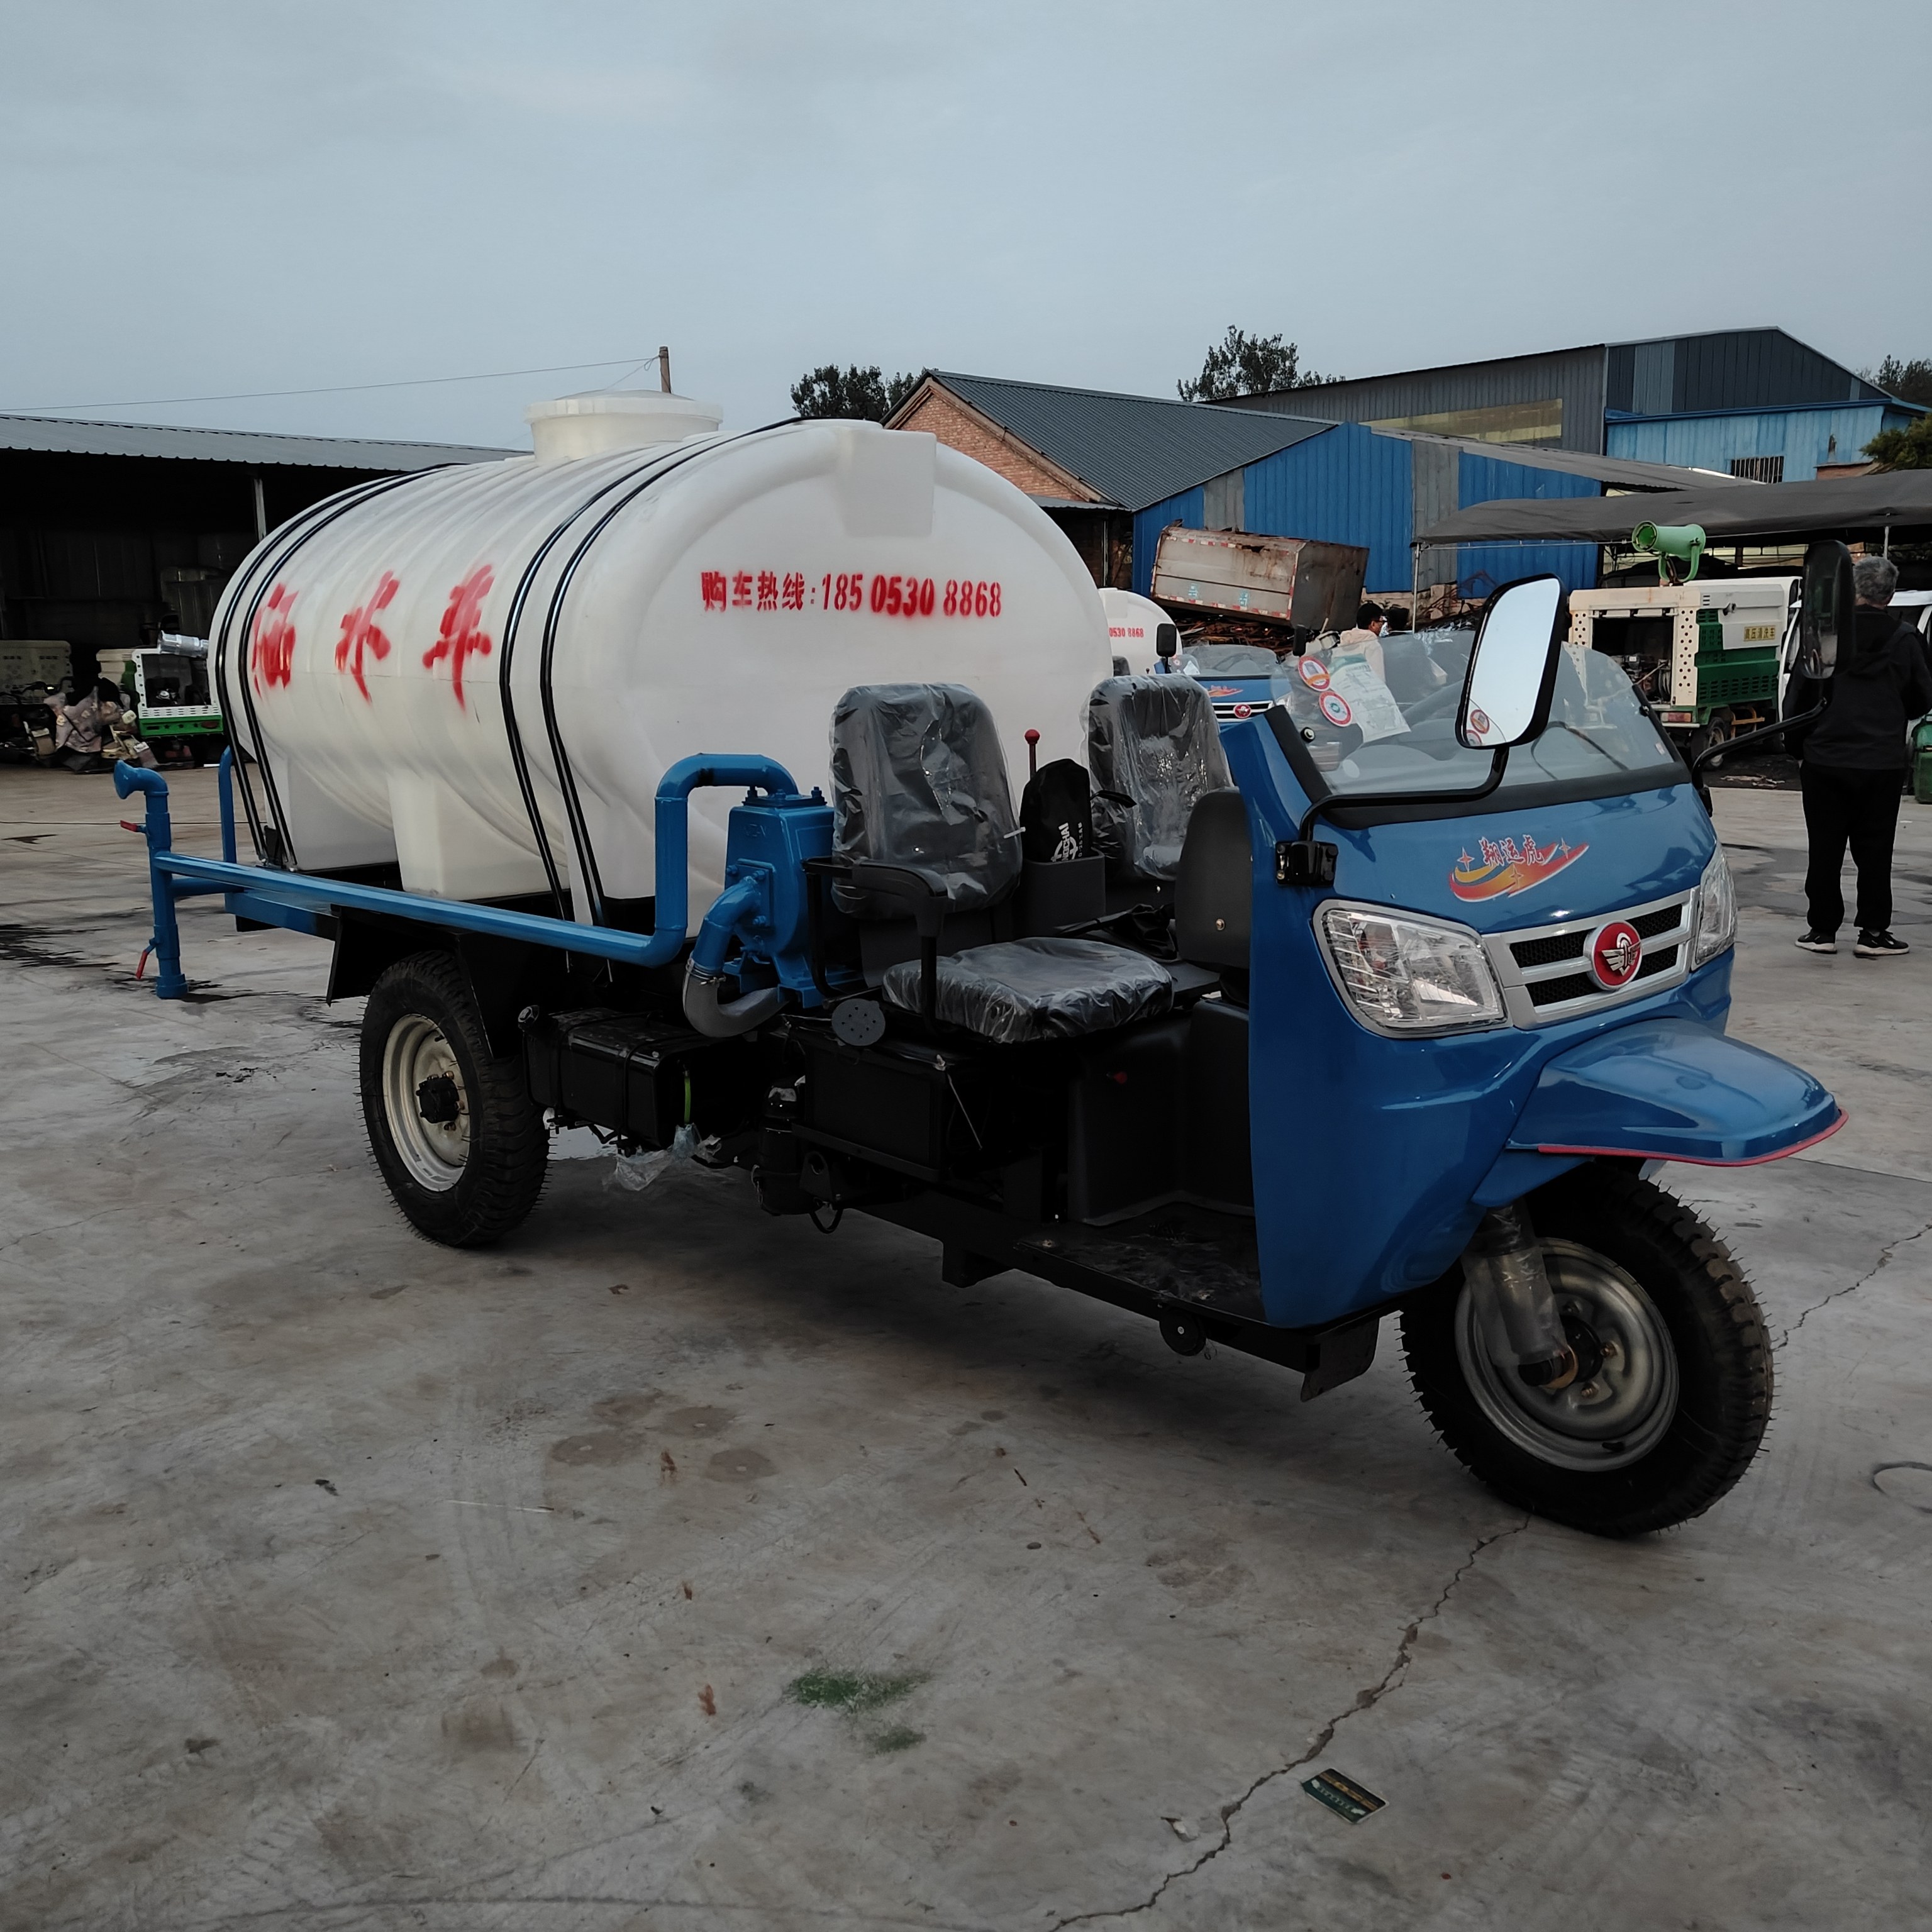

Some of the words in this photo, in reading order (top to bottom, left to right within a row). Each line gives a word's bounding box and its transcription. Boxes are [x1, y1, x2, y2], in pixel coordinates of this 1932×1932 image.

[821, 573, 863, 612] 185
[870, 574, 935, 617] 0530
[943, 579, 1002, 618] 8868
[1109, 627, 1126, 638] 0530
[1128, 627, 1144, 638] 8868
